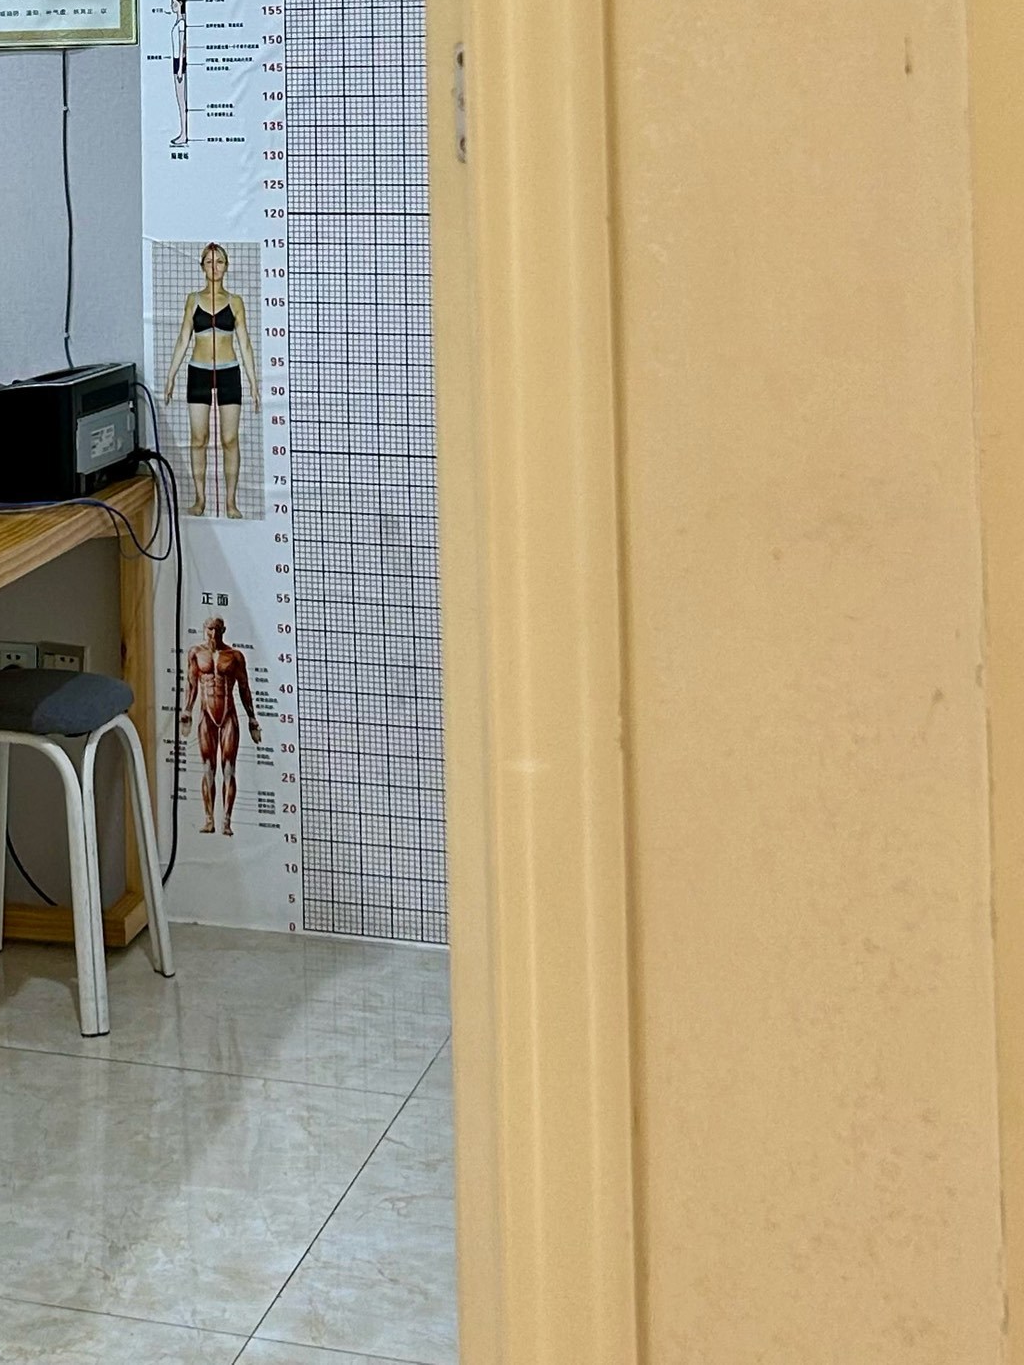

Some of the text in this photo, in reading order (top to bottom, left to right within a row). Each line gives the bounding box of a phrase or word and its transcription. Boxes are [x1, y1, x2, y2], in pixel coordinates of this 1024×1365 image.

[262, 6, 282, 15] 155
[262, 35, 282, 44] 150
[262, 63, 282, 72] 145
[263, 92, 283, 101] 140
[263, 122, 283, 131] 135
[263, 151, 283, 160] 130
[264, 180, 284, 189] 125
[264, 209, 284, 218] 120
[264, 239, 284, 248] 115
[264, 269, 285, 277] 110
[265, 298, 285, 307] 105
[265, 328, 285, 337] 100
[271, 357, 284, 366] 95
[271, 387, 285, 396] 90
[272, 416, 285, 425] 85
[273, 446, 286, 455] 80
[273, 476, 286, 485] 75
[274, 504, 287, 514] 70
[275, 533, 288, 543] 65
[276, 564, 289, 573] 60
[201, 592, 229, 607] 正面
[277, 594, 290, 603] 55
[278, 624, 291, 634] 50
[278, 654, 292, 663] 45
[279, 684, 293, 693] 40
[280, 713, 293, 723] 35
[281, 744, 295, 753] 30
[282, 773, 295, 783] 25
[283, 804, 296, 813] 20
[284, 834, 297, 843] 15
[285, 864, 298, 873] 10
